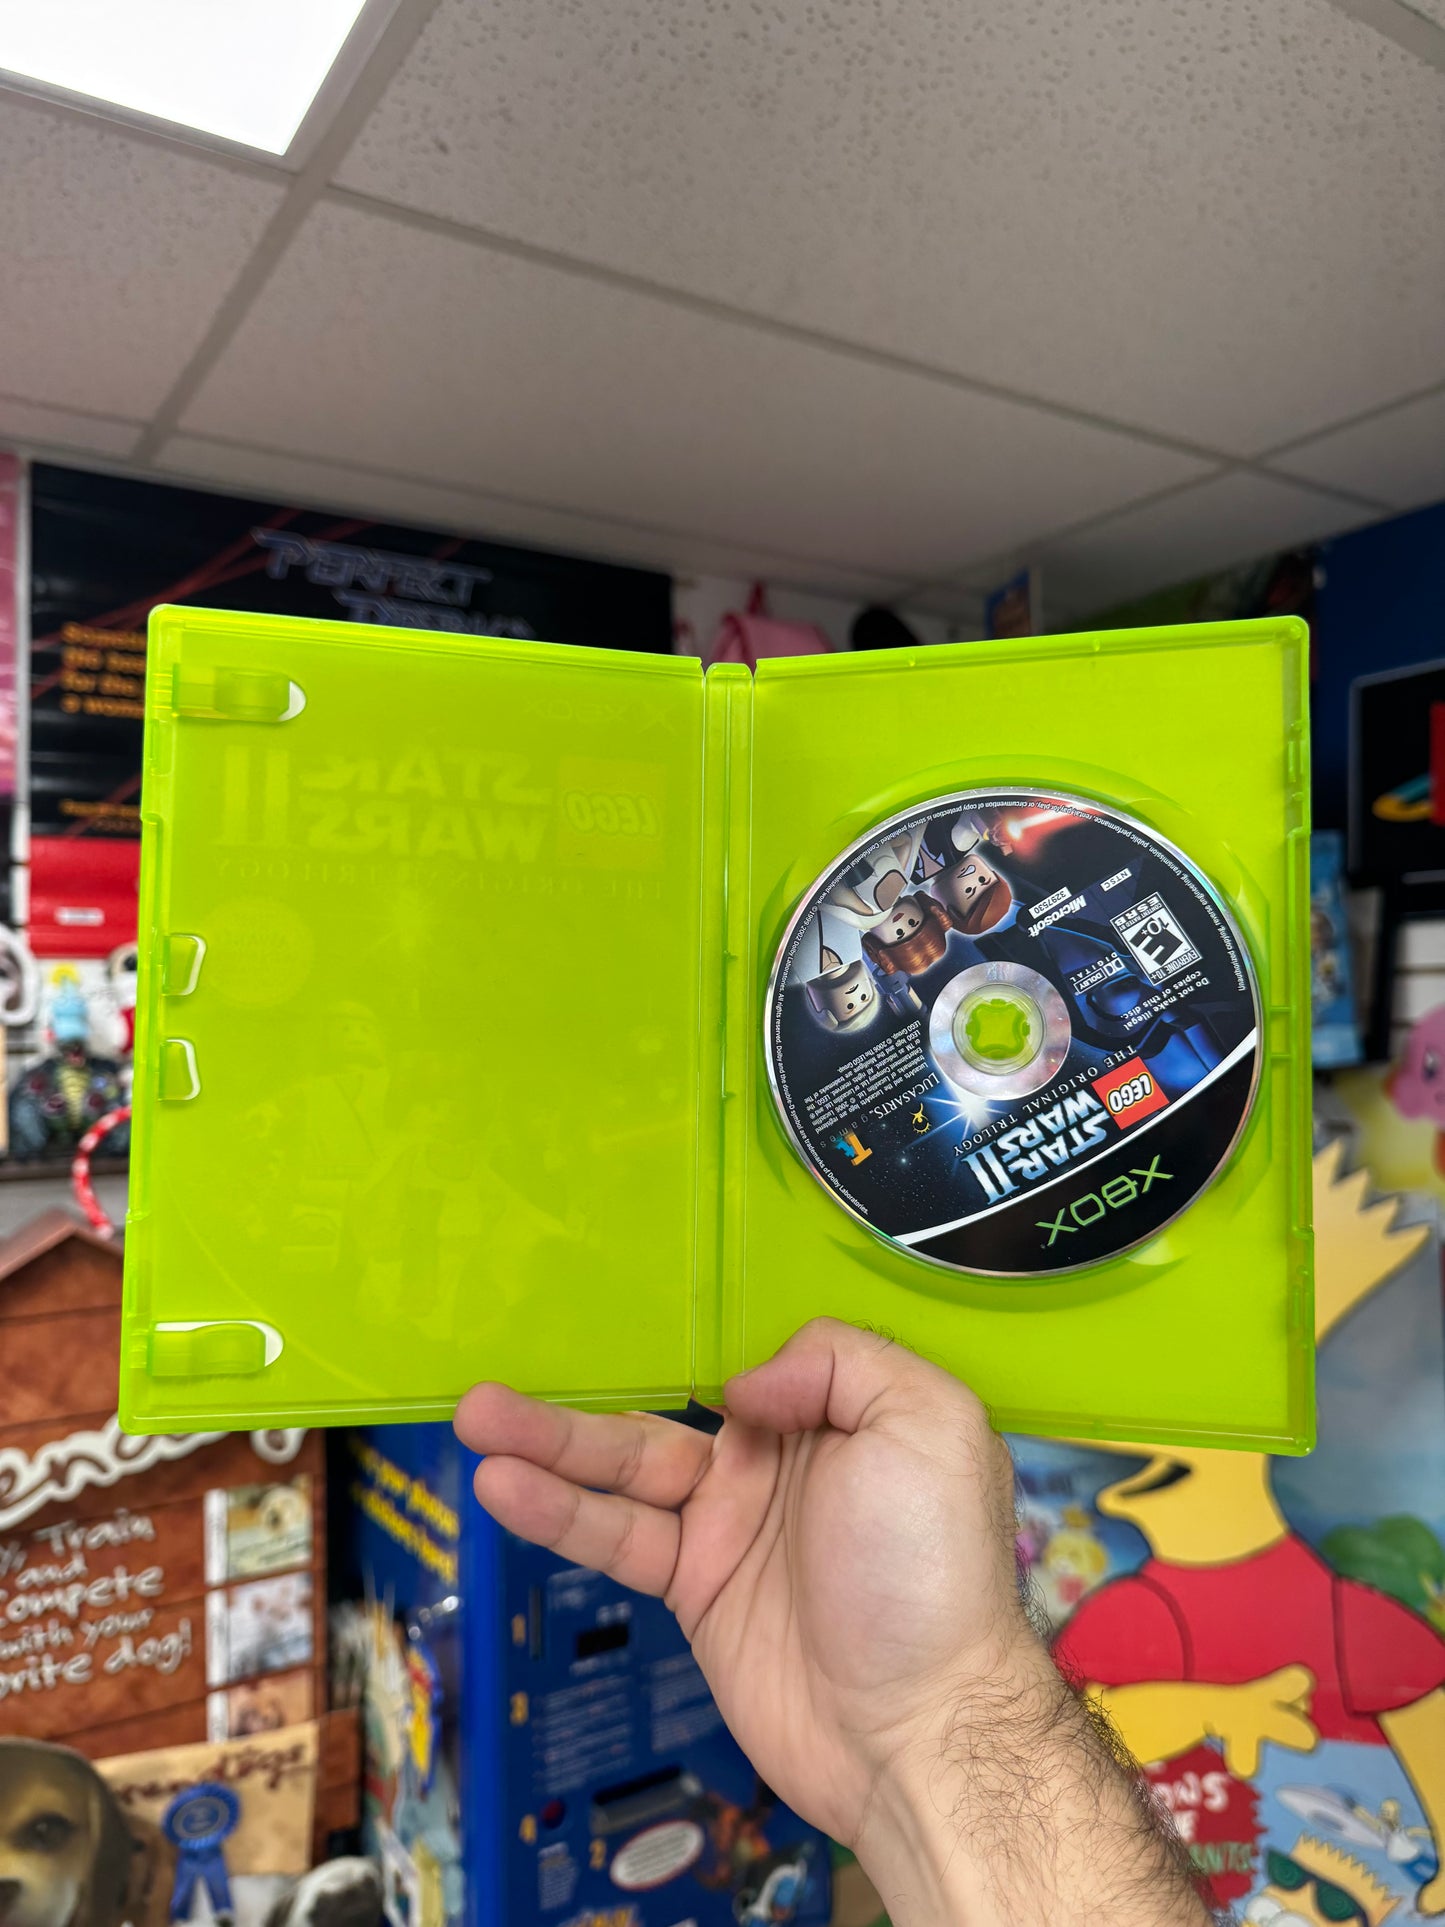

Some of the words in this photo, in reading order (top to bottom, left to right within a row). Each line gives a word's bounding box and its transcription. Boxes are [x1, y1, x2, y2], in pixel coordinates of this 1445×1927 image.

[931, 804, 962, 820] protection
[961, 801, 977, 811] copy
[984, 800, 1027, 809] circumvention
[905, 815, 927, 830] strictly
[1091, 813, 1133, 838] performance,
[1129, 831, 1150, 849] public
[849, 841, 880, 868] Confidential
[1145, 842, 1183, 876] transmission,
[823, 863, 853, 894] unpublished
[1102, 869, 1128, 889] NTSC
[1178, 871, 1209, 906] engineering,
[1031, 889, 1067, 915] 3297530
[1113, 895, 1159, 927] ESRB
[1139, 901, 1162, 917] CONTENT
[1027, 894, 1086, 938] Microsoft
[1124, 913, 1142, 927] RATED
[1204, 903, 1221, 926] reverse
[1117, 923, 1126, 932] BY
[1215, 923, 1234, 951] copying,
[787, 939, 800, 957] Dolby
[1068, 950, 1117, 983] DIGITAL
[1163, 948, 1198, 975] EVERYONE
[1226, 949, 1245, 992] Unauthorized
[778, 955, 794, 993] Laboratories.
[1171, 968, 1202, 991] copies
[1194, 976, 1209, 989] Do
[1160, 987, 1172, 998] of
[1176, 984, 1195, 999] not
[774, 1001, 784, 1018] rights
[1141, 993, 1161, 1009] this
[1151, 994, 1178, 1014] make
[1119, 1004, 1142, 1022] disc.
[1121, 1007, 1153, 1031] illegal
[889, 1026, 908, 1042] Group,
[905, 1019, 921, 1032] LEGO
[893, 1036, 907, 1049] logo
[905, 1028, 920, 1042] LEGO
[913, 1037, 921, 1045] or
[774, 1044, 784, 1062] Dolby
[863, 1047, 874, 1058] The
[871, 1040, 887, 1053] 2006
[875, 1050, 886, 1060] the
[883, 1043, 896, 1055] and
[904, 1041, 915, 1051] TM
[851, 1053, 866, 1065] LEGO
[873, 1051, 899, 1071] indicated.
[888, 1046, 922, 1070] Entertainment
[896, 1053, 925, 1075] trademarks
[1101, 1043, 1137, 1068] THE
[835, 1059, 854, 1075] Group.
[843, 1070, 853, 1078] are
[865, 1066, 875, 1075] All
[867, 1064, 891, 1083] Company
[889, 1070, 897, 1079] of
[902, 1061, 928, 1080] LucasArts
[817, 1075, 845, 1096] trademarks
[850, 1070, 867, 1084] rights
[858, 1078, 870, 1089] Ltd.
[866, 1075, 890, 1094] Lucasfilm
[892, 1075, 904, 1086] and
[811, 1091, 820, 1099] of
[829, 1080, 852, 1097] reserved.
[831, 1087, 855, 1105] Lucasfilm
[853, 1083, 860, 1091] or
[855, 1089, 867, 1100] Ltd.
[882, 1082, 893, 1092] the
[1020, 1065, 1098, 1115] ORIGINAL
[1106, 1071, 1152, 1115] LEGO
[781, 1083, 795, 1110] double-D
[803, 1094, 814, 1105] The
[814, 1092, 831, 1107] LEGO,
[823, 1100, 834, 1110] Ltd.
[859, 1088, 884, 1107] LucasArts
[805, 1102, 816, 1112] the
[813, 1105, 825, 1116] and
[833, 1100, 849, 1113] 2006
[837, 1110, 848, 1119] are
[846, 1101, 860, 1114] logo
[788, 1108, 803, 1131] symbol
[810, 1109, 835, 1128] Lucasfilm
[813, 1114, 839, 1134] registered
[993, 1087, 1102, 1163] WARS
[950, 1112, 1018, 1156] TRILOGY
[803, 1137, 826, 1169] trademarks
[1005, 1109, 1109, 1183] STAR
[825, 1171, 842, 1189] Dolby
[837, 1184, 871, 1215] Laboratories.
[1033, 1153, 1174, 1247] XBOX
[33, 1507, 155, 1556] Train
[15, 1550, 88, 1591] and
[79, 1607, 155, 1649] your
[104, 1616, 192, 1675] dog!
